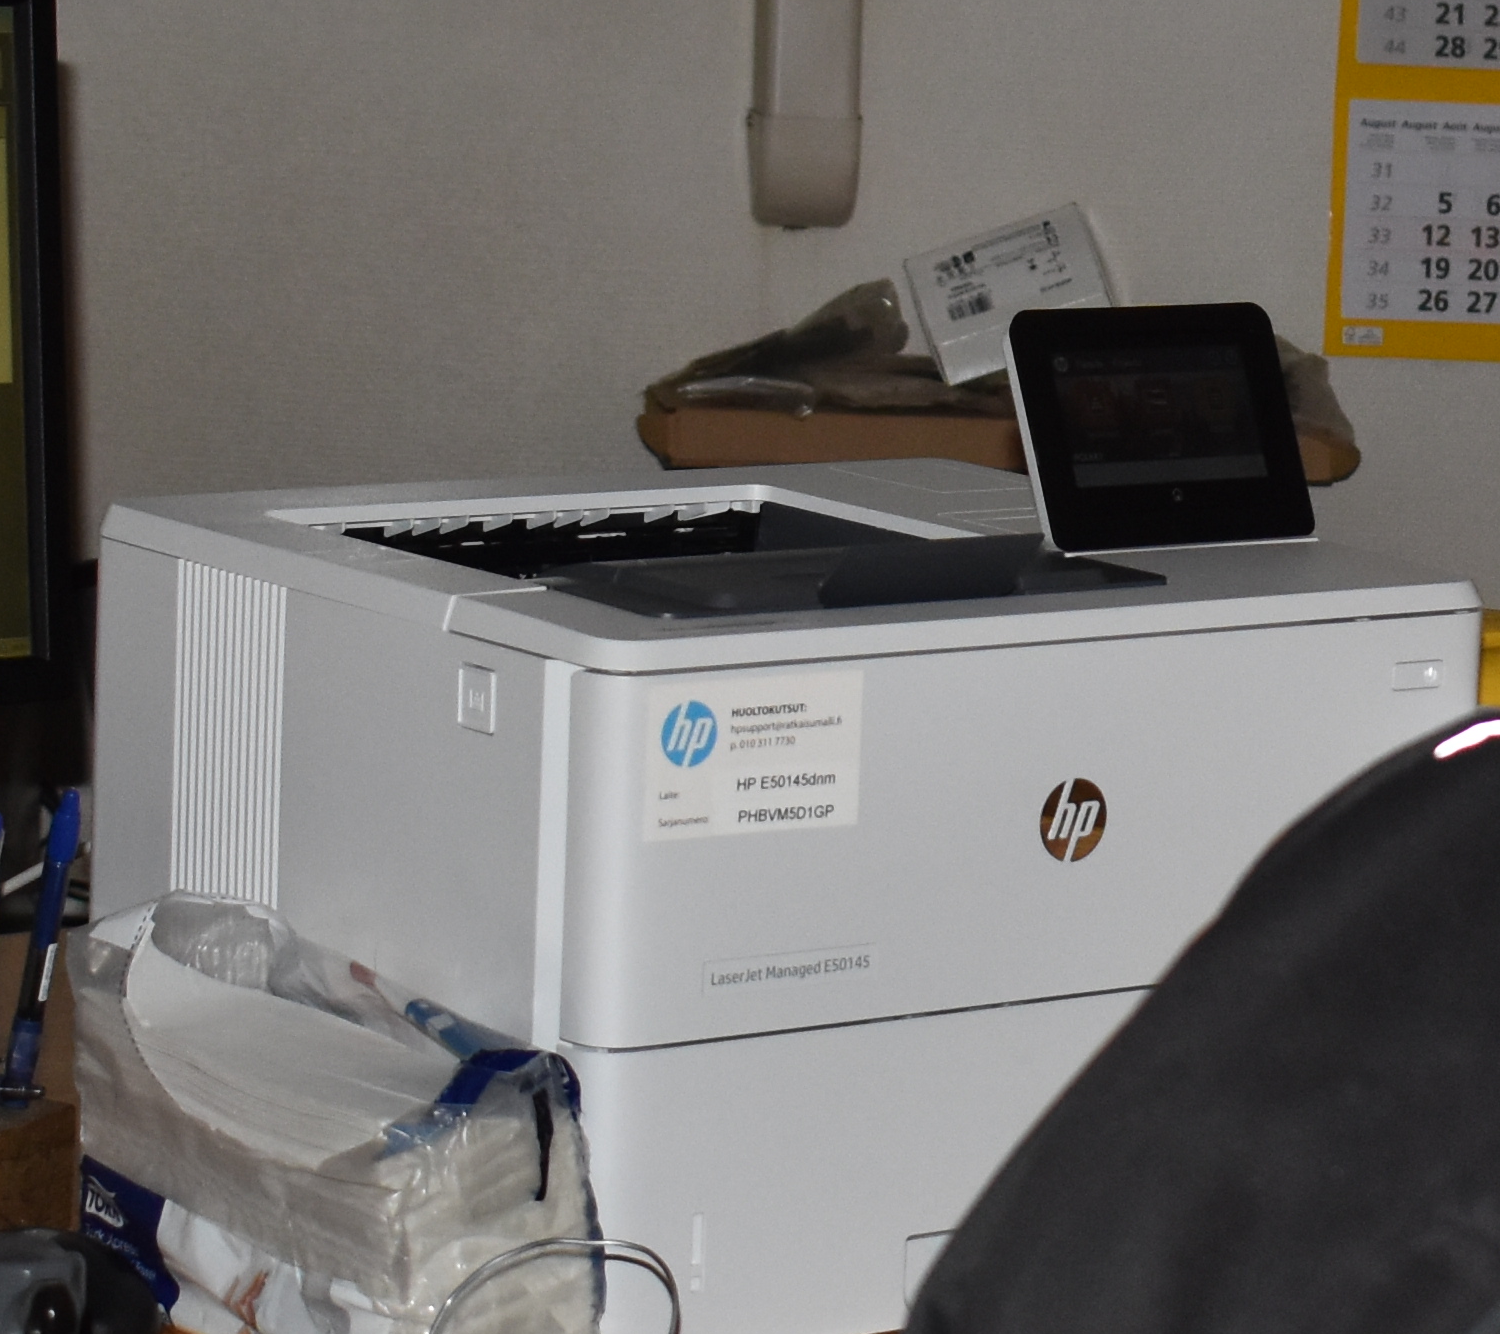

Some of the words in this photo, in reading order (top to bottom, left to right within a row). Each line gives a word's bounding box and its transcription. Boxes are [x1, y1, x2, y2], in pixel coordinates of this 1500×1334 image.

[1436, 2, 1464, 25] 21
[1435, 35, 1466, 58] 28
[1439, 192, 1452, 214] 5
[1487, 194, 1500, 216] 6
[1422, 224, 1451, 247] 12
[1471, 226, 1500, 250] 13
[1421, 257, 1450, 279] 19
[1468, 258, 1499, 281] 20
[1418, 289, 1449, 312] 26
[1467, 291, 1497, 314] 27
[731, 703, 807, 717] HUOLTOKUTSUT:
[666, 701, 714, 768] hp
[739, 739, 755, 750] 010
[757, 738, 772, 748] 311
[775, 736, 796, 747] 7730
[736, 778, 756, 791] HP
[760, 773, 836, 790] E50145dnm
[738, 804, 835, 823] PHBVM5D1GP
[1045, 779, 1102, 862] hp
[710, 968, 762, 987] LaserJet
[765, 961, 821, 980] Managed
[824, 955, 871, 973] E50145
